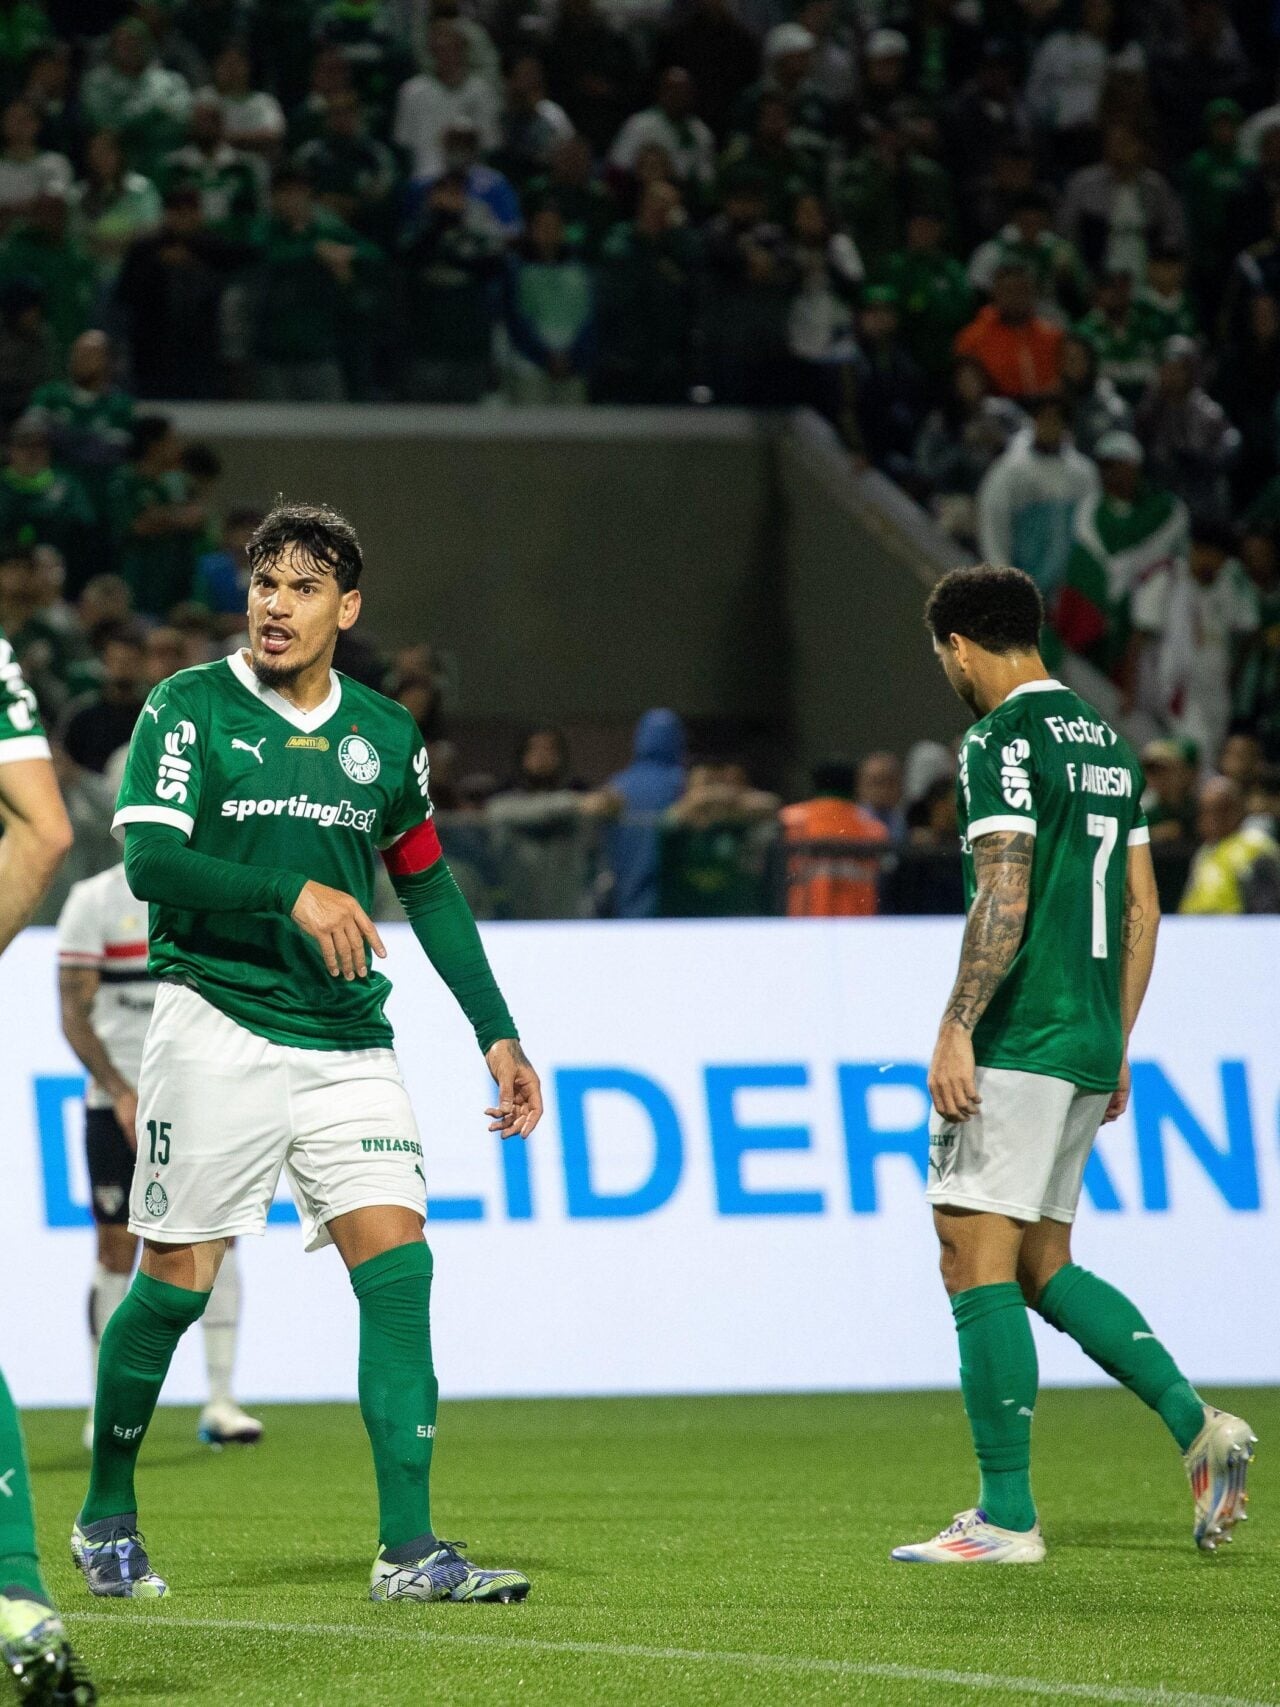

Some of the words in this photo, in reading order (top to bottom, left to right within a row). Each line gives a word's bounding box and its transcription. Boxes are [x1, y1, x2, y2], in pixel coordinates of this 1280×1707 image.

[1044, 715, 1106, 748] Fictor
[341, 753, 378, 781] PALMEIRAS
[1066, 762, 1077, 793] F
[221, 794, 377, 833] sportingbet
[1086, 812, 1119, 959] 7
[146, 1119, 172, 1166] 15
[113, 1424, 143, 1440] SEP
